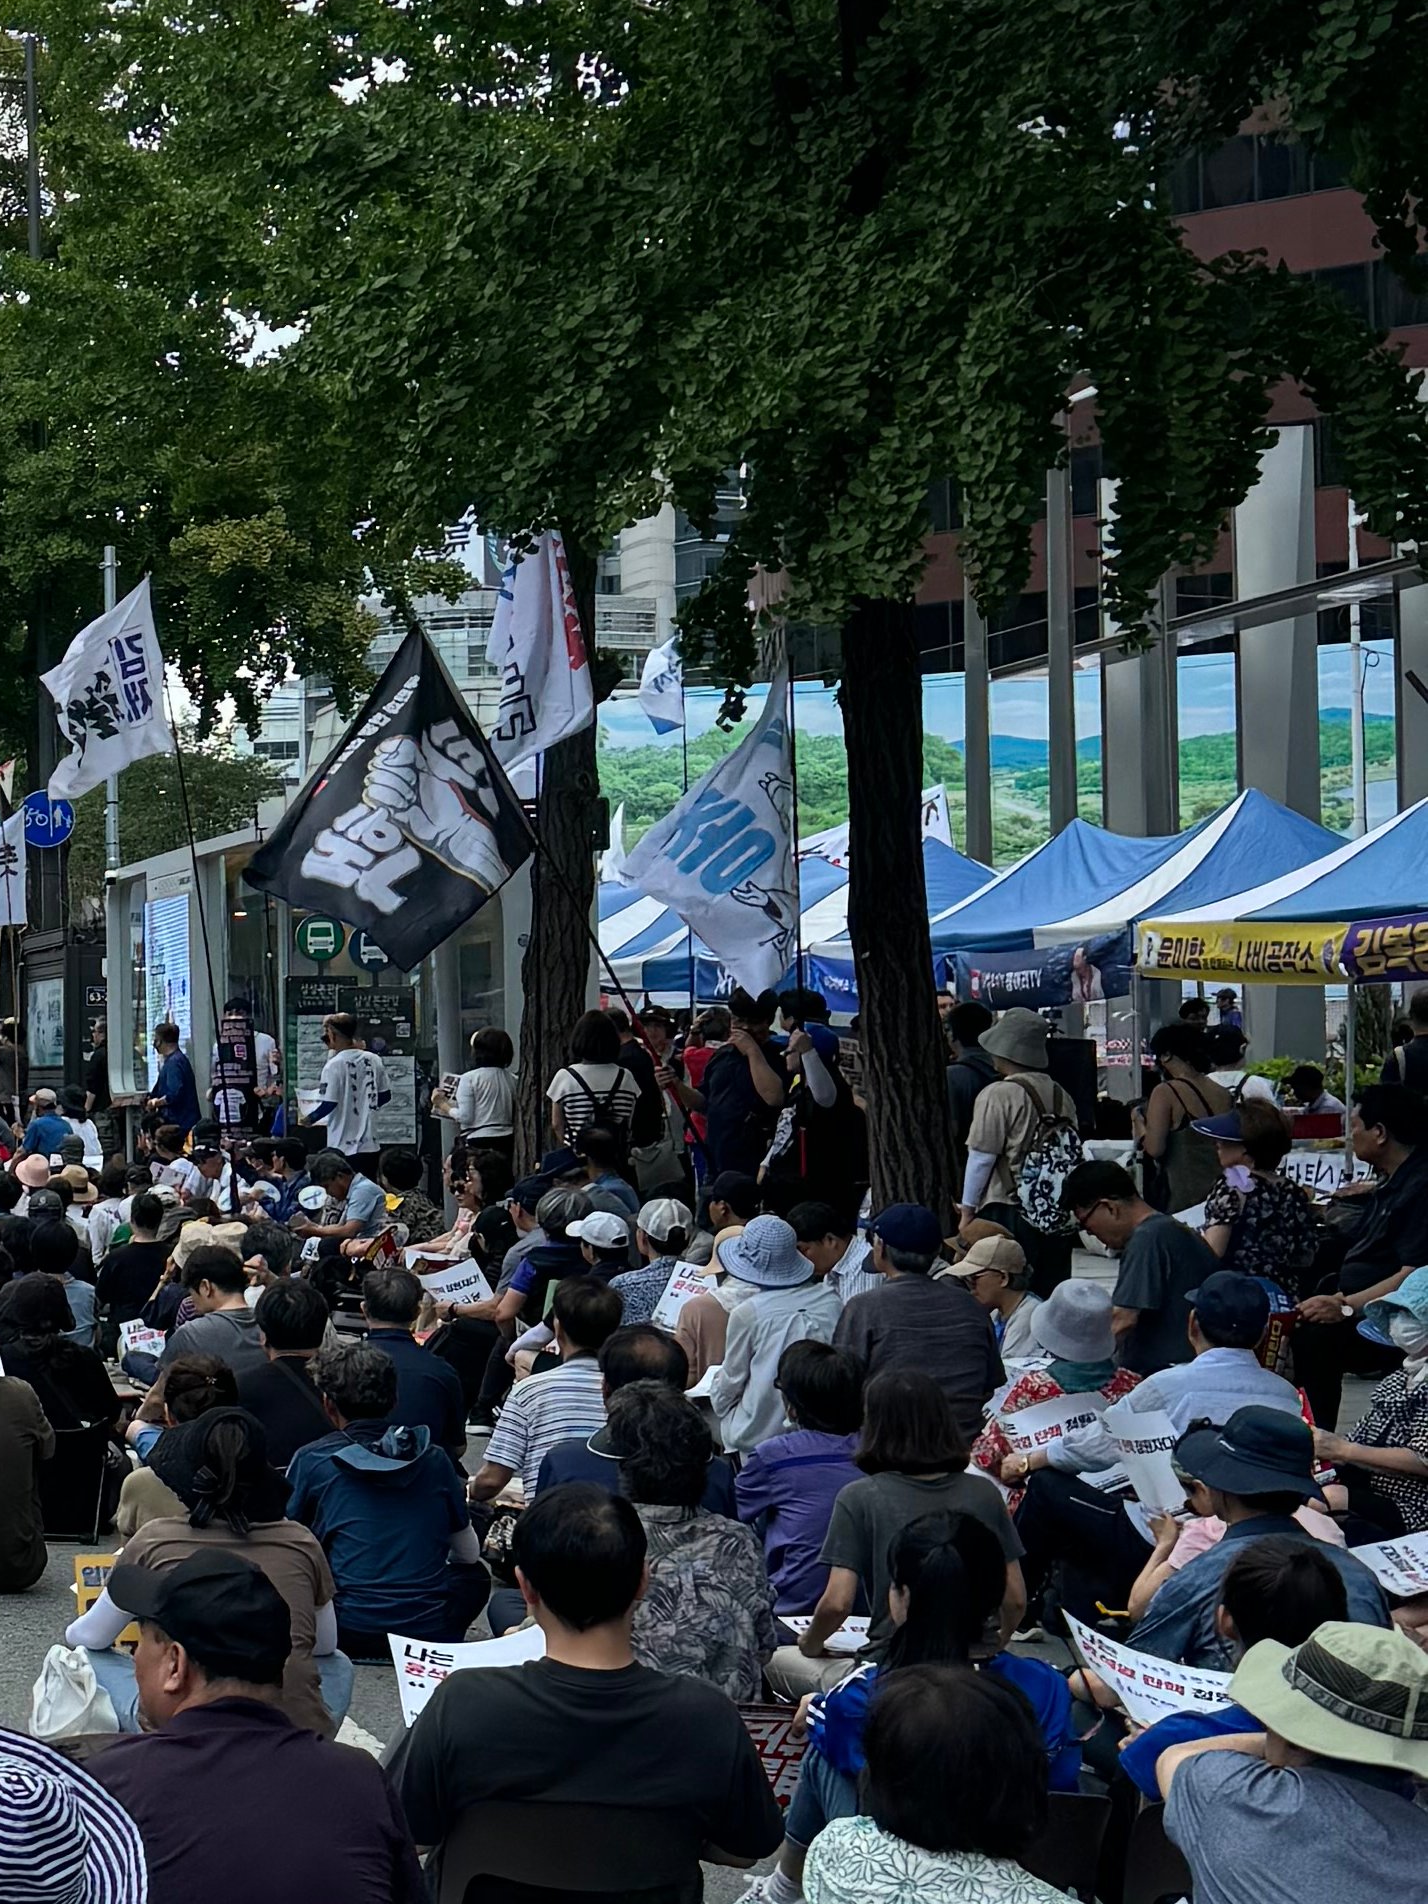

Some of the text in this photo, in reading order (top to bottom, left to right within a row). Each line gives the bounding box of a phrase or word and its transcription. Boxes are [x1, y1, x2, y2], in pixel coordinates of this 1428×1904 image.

[1157, 937, 1317, 974] 윤미향 나비공작소
[405, 1644, 454, 1668] 나는
